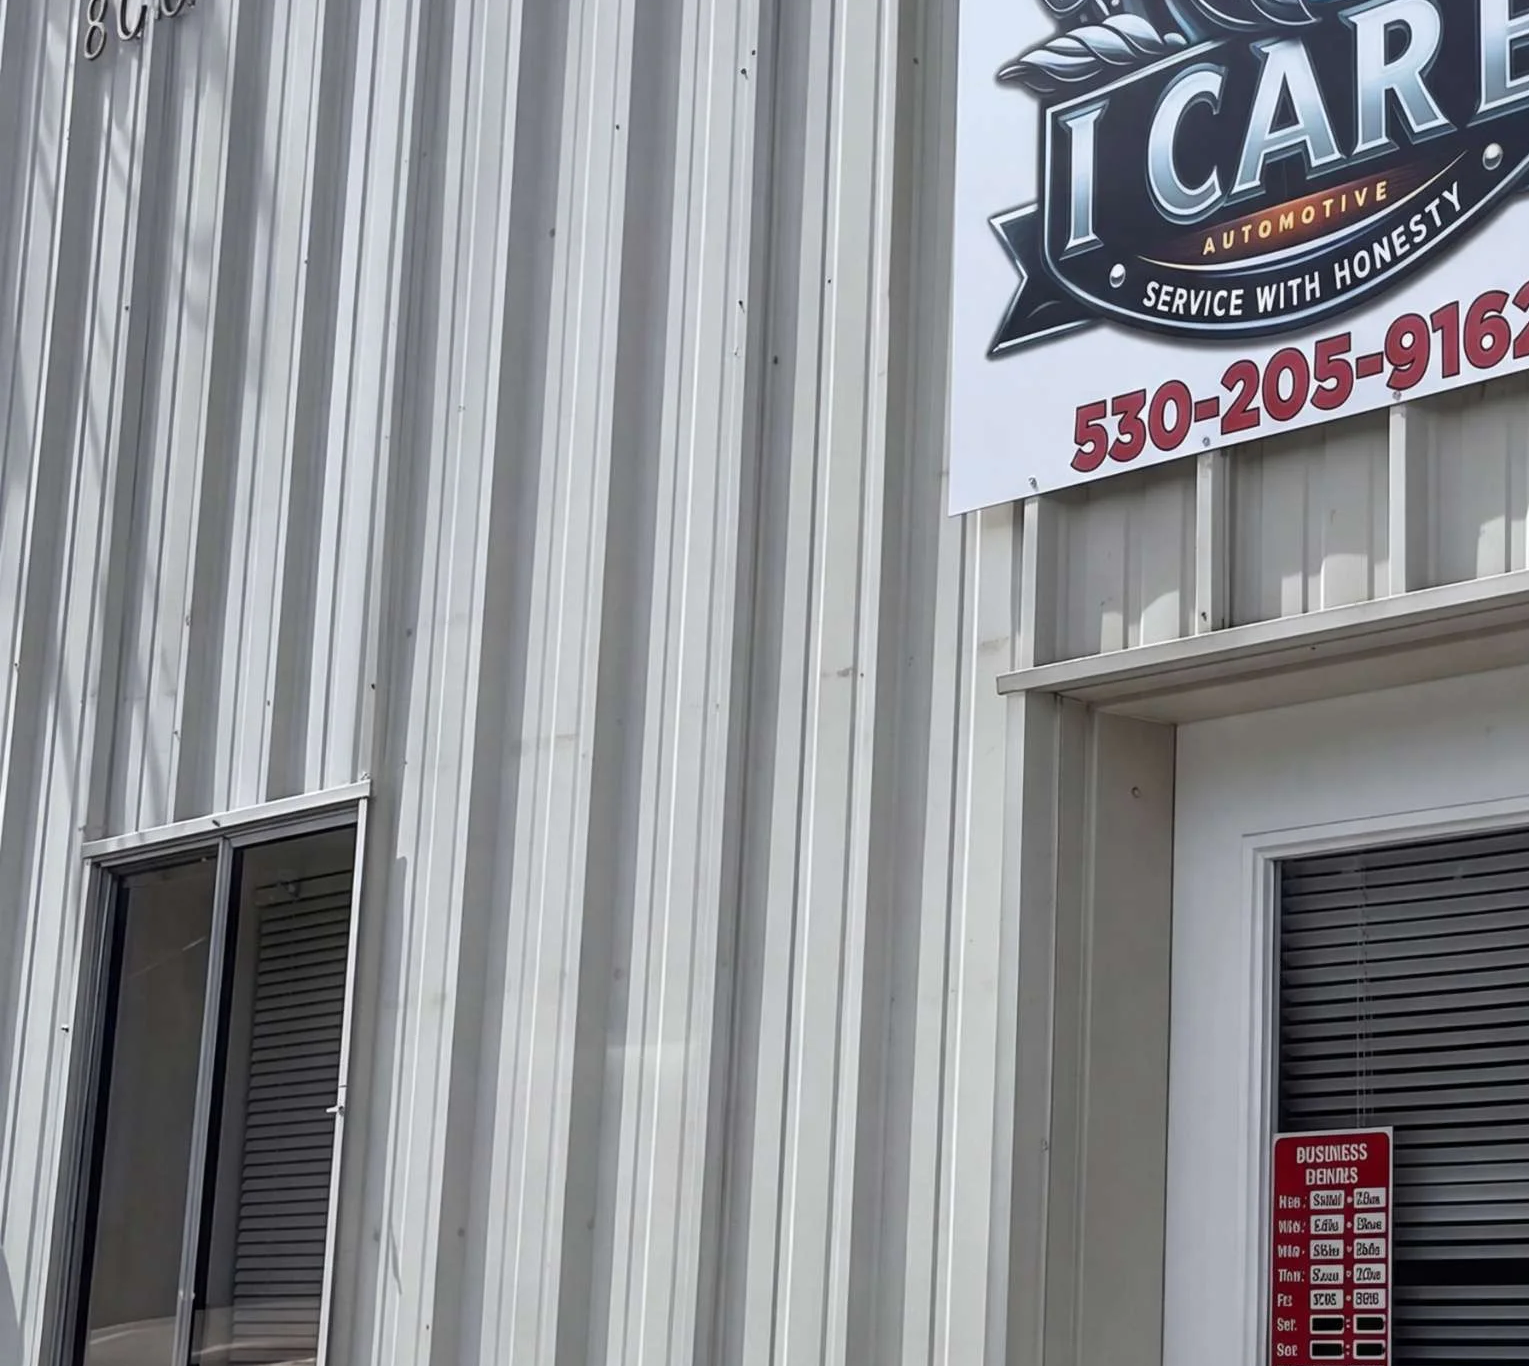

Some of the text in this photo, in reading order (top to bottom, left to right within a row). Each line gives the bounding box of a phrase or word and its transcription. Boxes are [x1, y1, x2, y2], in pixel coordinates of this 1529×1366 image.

[1060, 103, 1107, 261] I
[1142, 181, 1466, 318] SERVICE WITH HONESTY
[1202, 181, 1390, 256] AUTOMOTIVE
